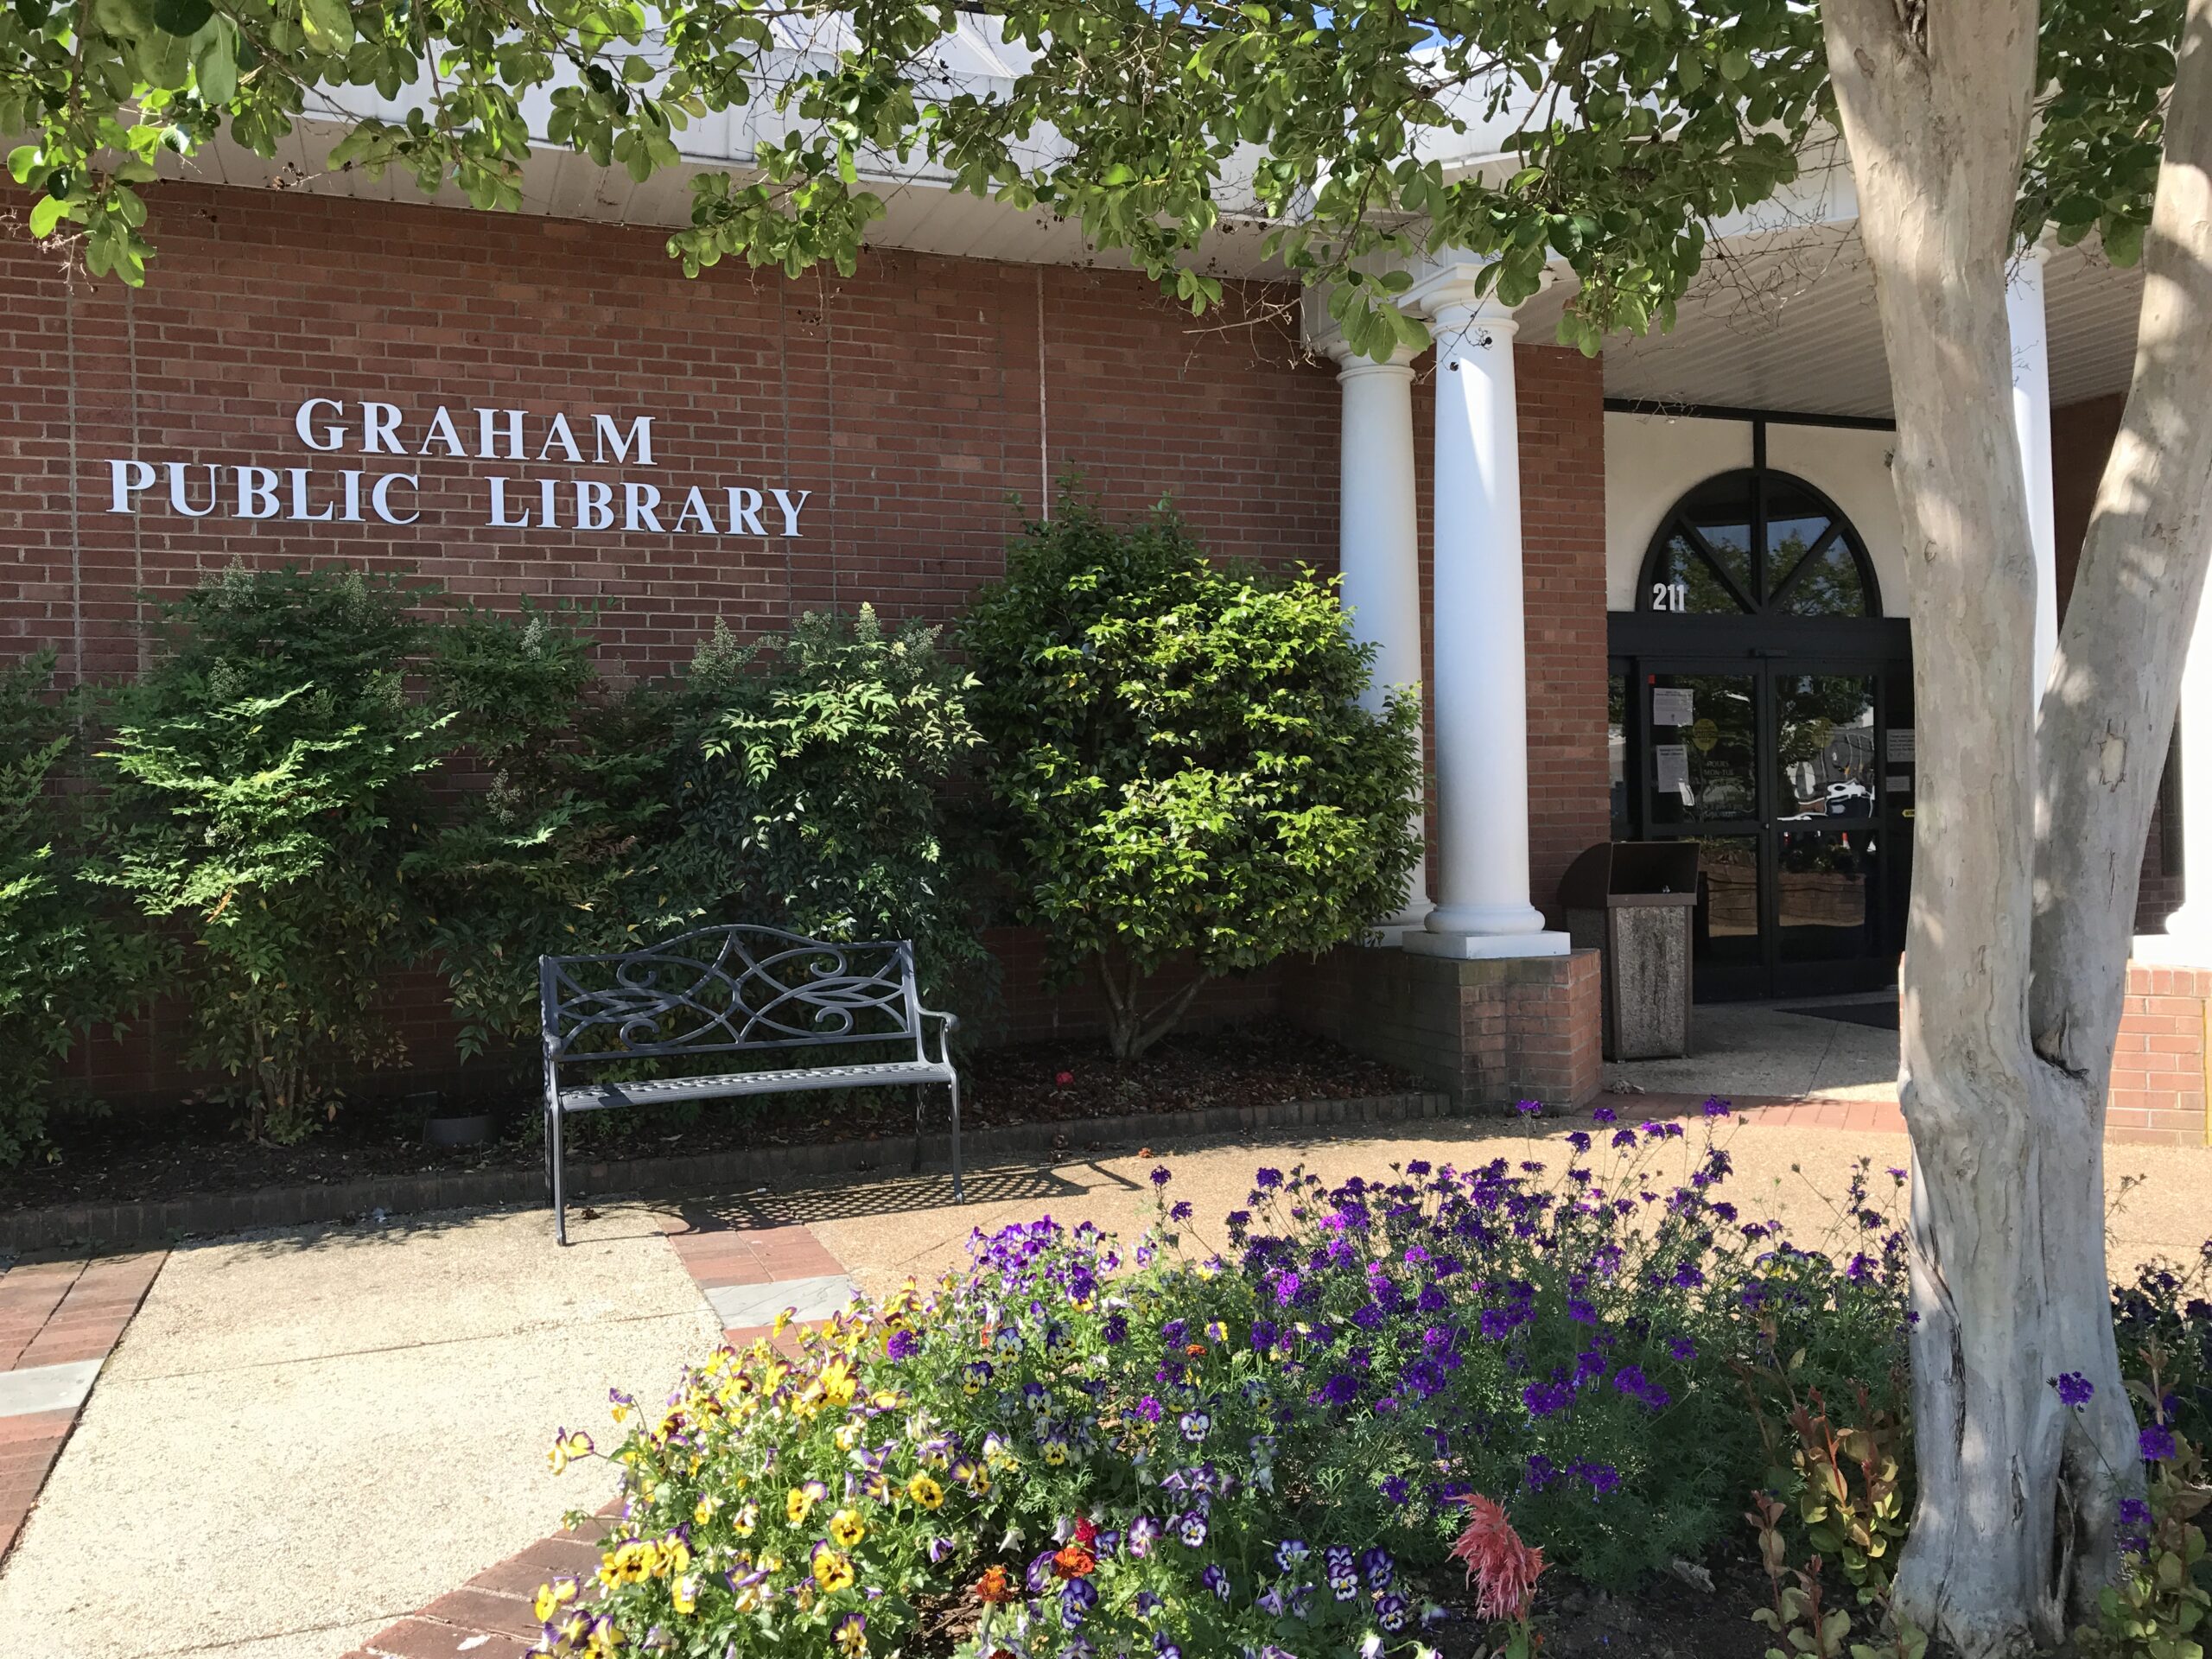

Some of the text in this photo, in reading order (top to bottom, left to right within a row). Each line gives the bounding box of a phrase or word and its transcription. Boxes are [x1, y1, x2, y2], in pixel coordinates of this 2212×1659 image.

[296, 397, 658, 466] GRAHAM
[104, 459, 812, 537] PUBLIC LIBRARY
[1653, 582, 1685, 611] 211
